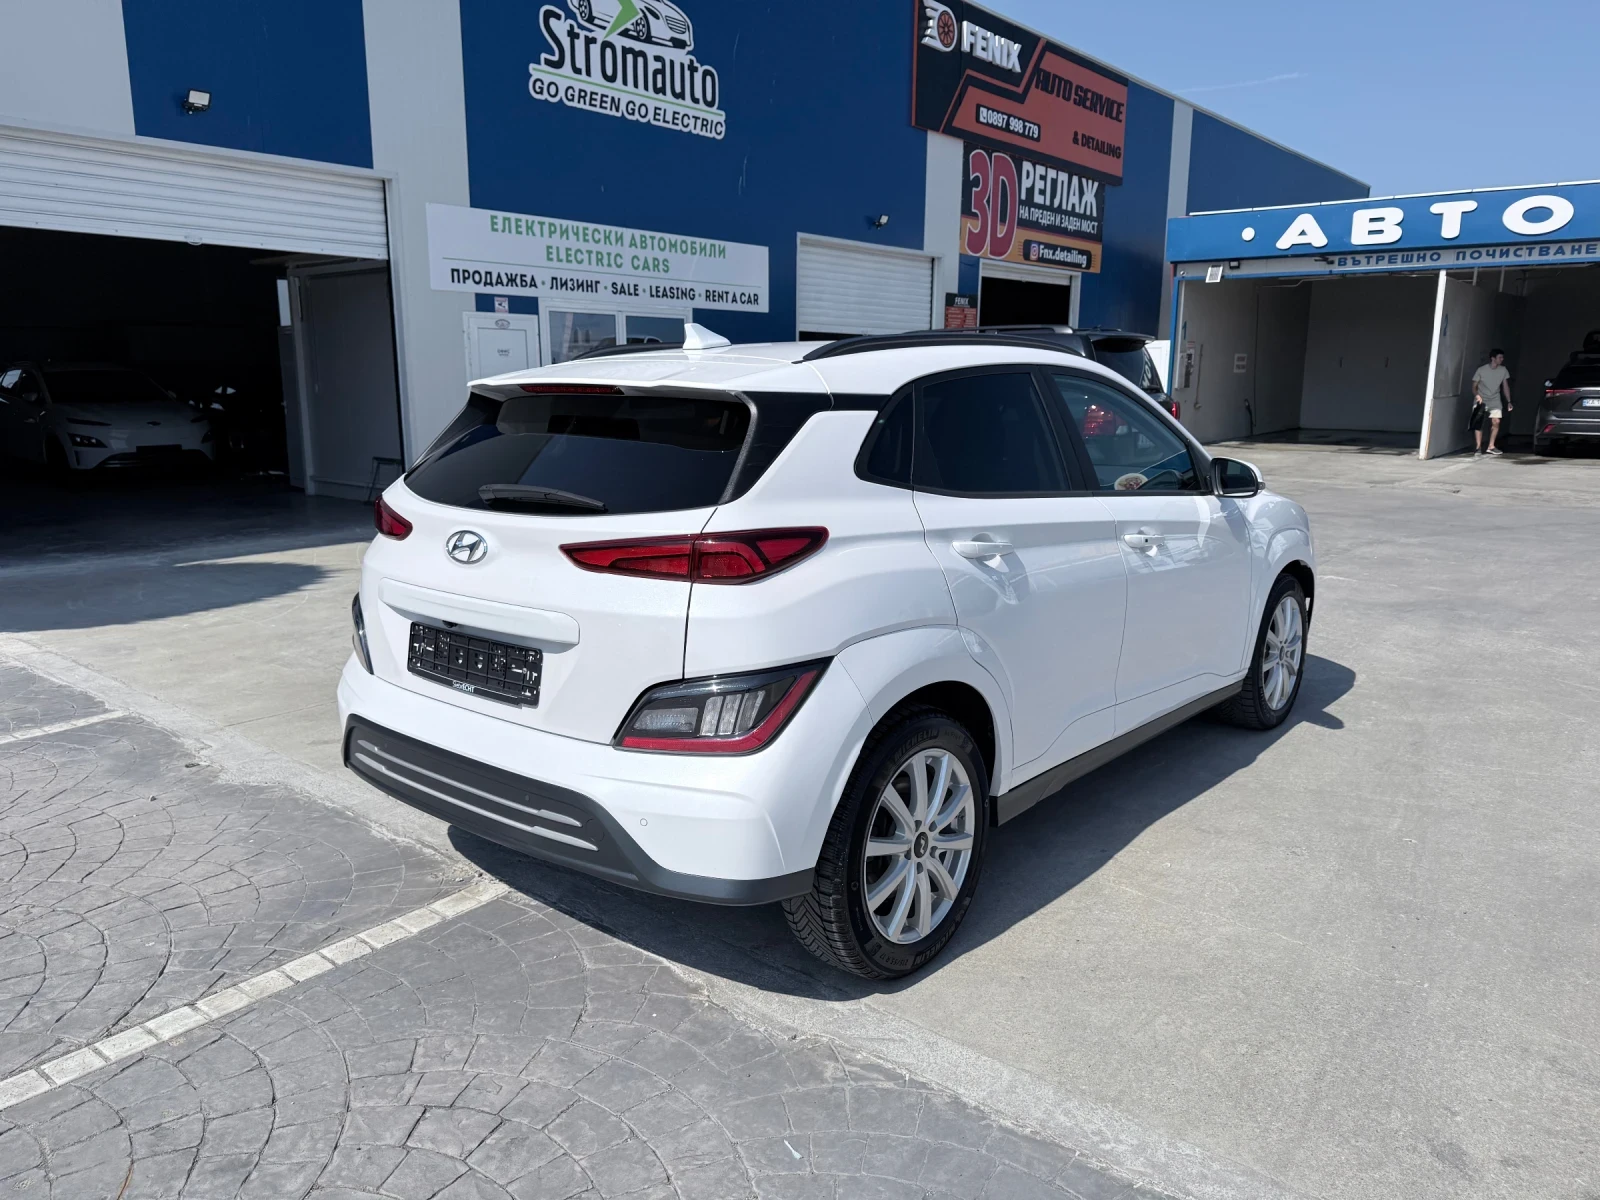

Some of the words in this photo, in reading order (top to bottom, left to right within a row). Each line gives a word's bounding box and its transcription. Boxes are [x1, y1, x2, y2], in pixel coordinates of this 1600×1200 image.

[542, 8, 718, 109] Stromauto
[961, 20, 1022, 73] FENIX
[531, 78, 559, 98] GO
[564, 86, 621, 113] GREEN
[625, 100, 649, 119] GO
[652, 107, 724, 136] ELECTRIC
[1034, 68, 1073, 102] AUTO
[1073, 85, 1125, 123] SERVICE
[987, 108, 1008, 129] 0897
[1009, 116, 1024, 133] 998
[1024, 120, 1039, 138] 779
[1072, 131, 1079, 146] &
[1081, 134, 1122, 159] DETAILING
[965, 149, 1019, 260] 3D
[1020, 161, 1100, 218] РЕГЛАЖ
[489, 214, 624, 247] ЕЛЕКТРИЧЕСКИ
[628, 232, 727, 259] АВТОМОБИЛИ
[1019, 205, 1029, 219] НА
[1029, 209, 1055, 227] ПРЕДЕН
[1055, 213, 1060, 226] И
[1061, 214, 1081, 232] ЗАДЕН
[1081, 218, 1099, 235] МОСТ
[1275, 194, 1575, 251] АВТО
[545, 245, 624, 269] ELECTRIC
[631, 254, 671, 273] CARS
[1039, 244, 1087, 268] Fnx.detailing
[1337, 251, 1442, 267] ВЪТРЕШНО
[1455, 243, 1599, 261] ПОЧИСТВАНЕ
[451, 268, 538, 289] ПРОДАЖБА
[549, 276, 600, 293] ЛИЗИНГ
[611, 281, 639, 297] SALE
[649, 285, 696, 300] LEASING
[705, 289, 729, 303] RENT
[731, 292, 738, 304] A
[739, 292, 759, 306] CAR
